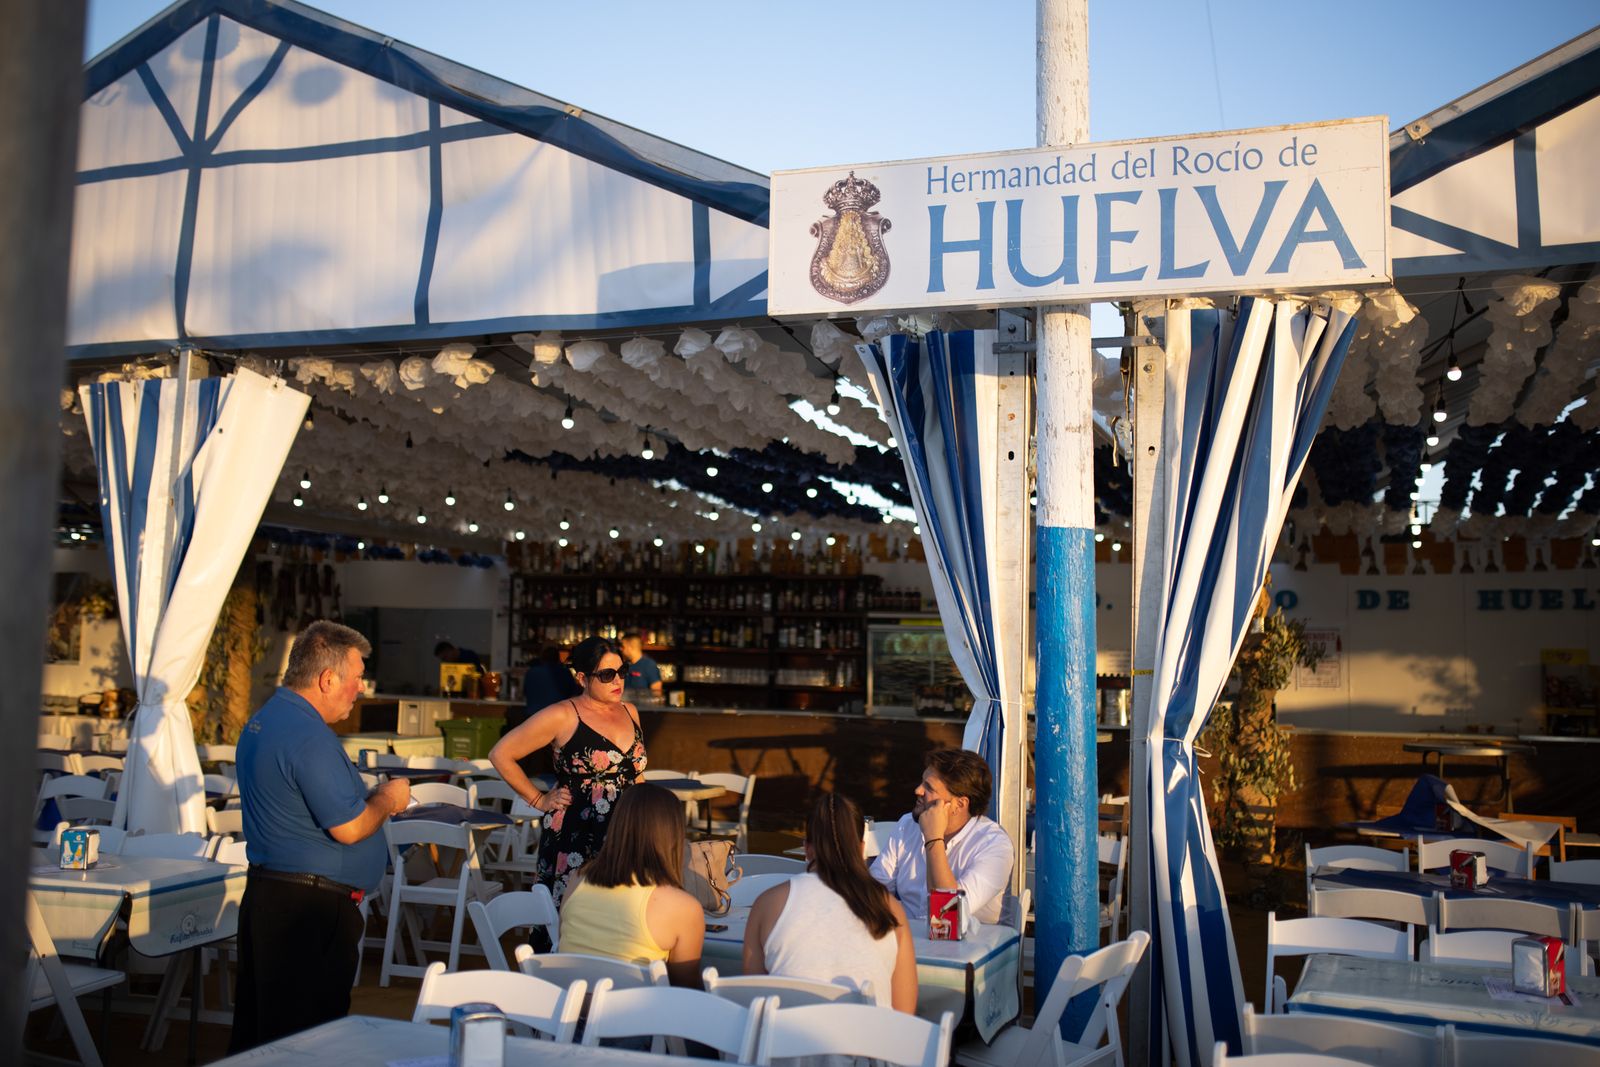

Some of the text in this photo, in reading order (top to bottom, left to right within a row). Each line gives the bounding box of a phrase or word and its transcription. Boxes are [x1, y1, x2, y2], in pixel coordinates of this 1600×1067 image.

[926, 137, 1318, 195] Hermandad del Rocío de
[926, 177, 1368, 293] HUELVA
[1356, 588, 1600, 610] DE HUEL
